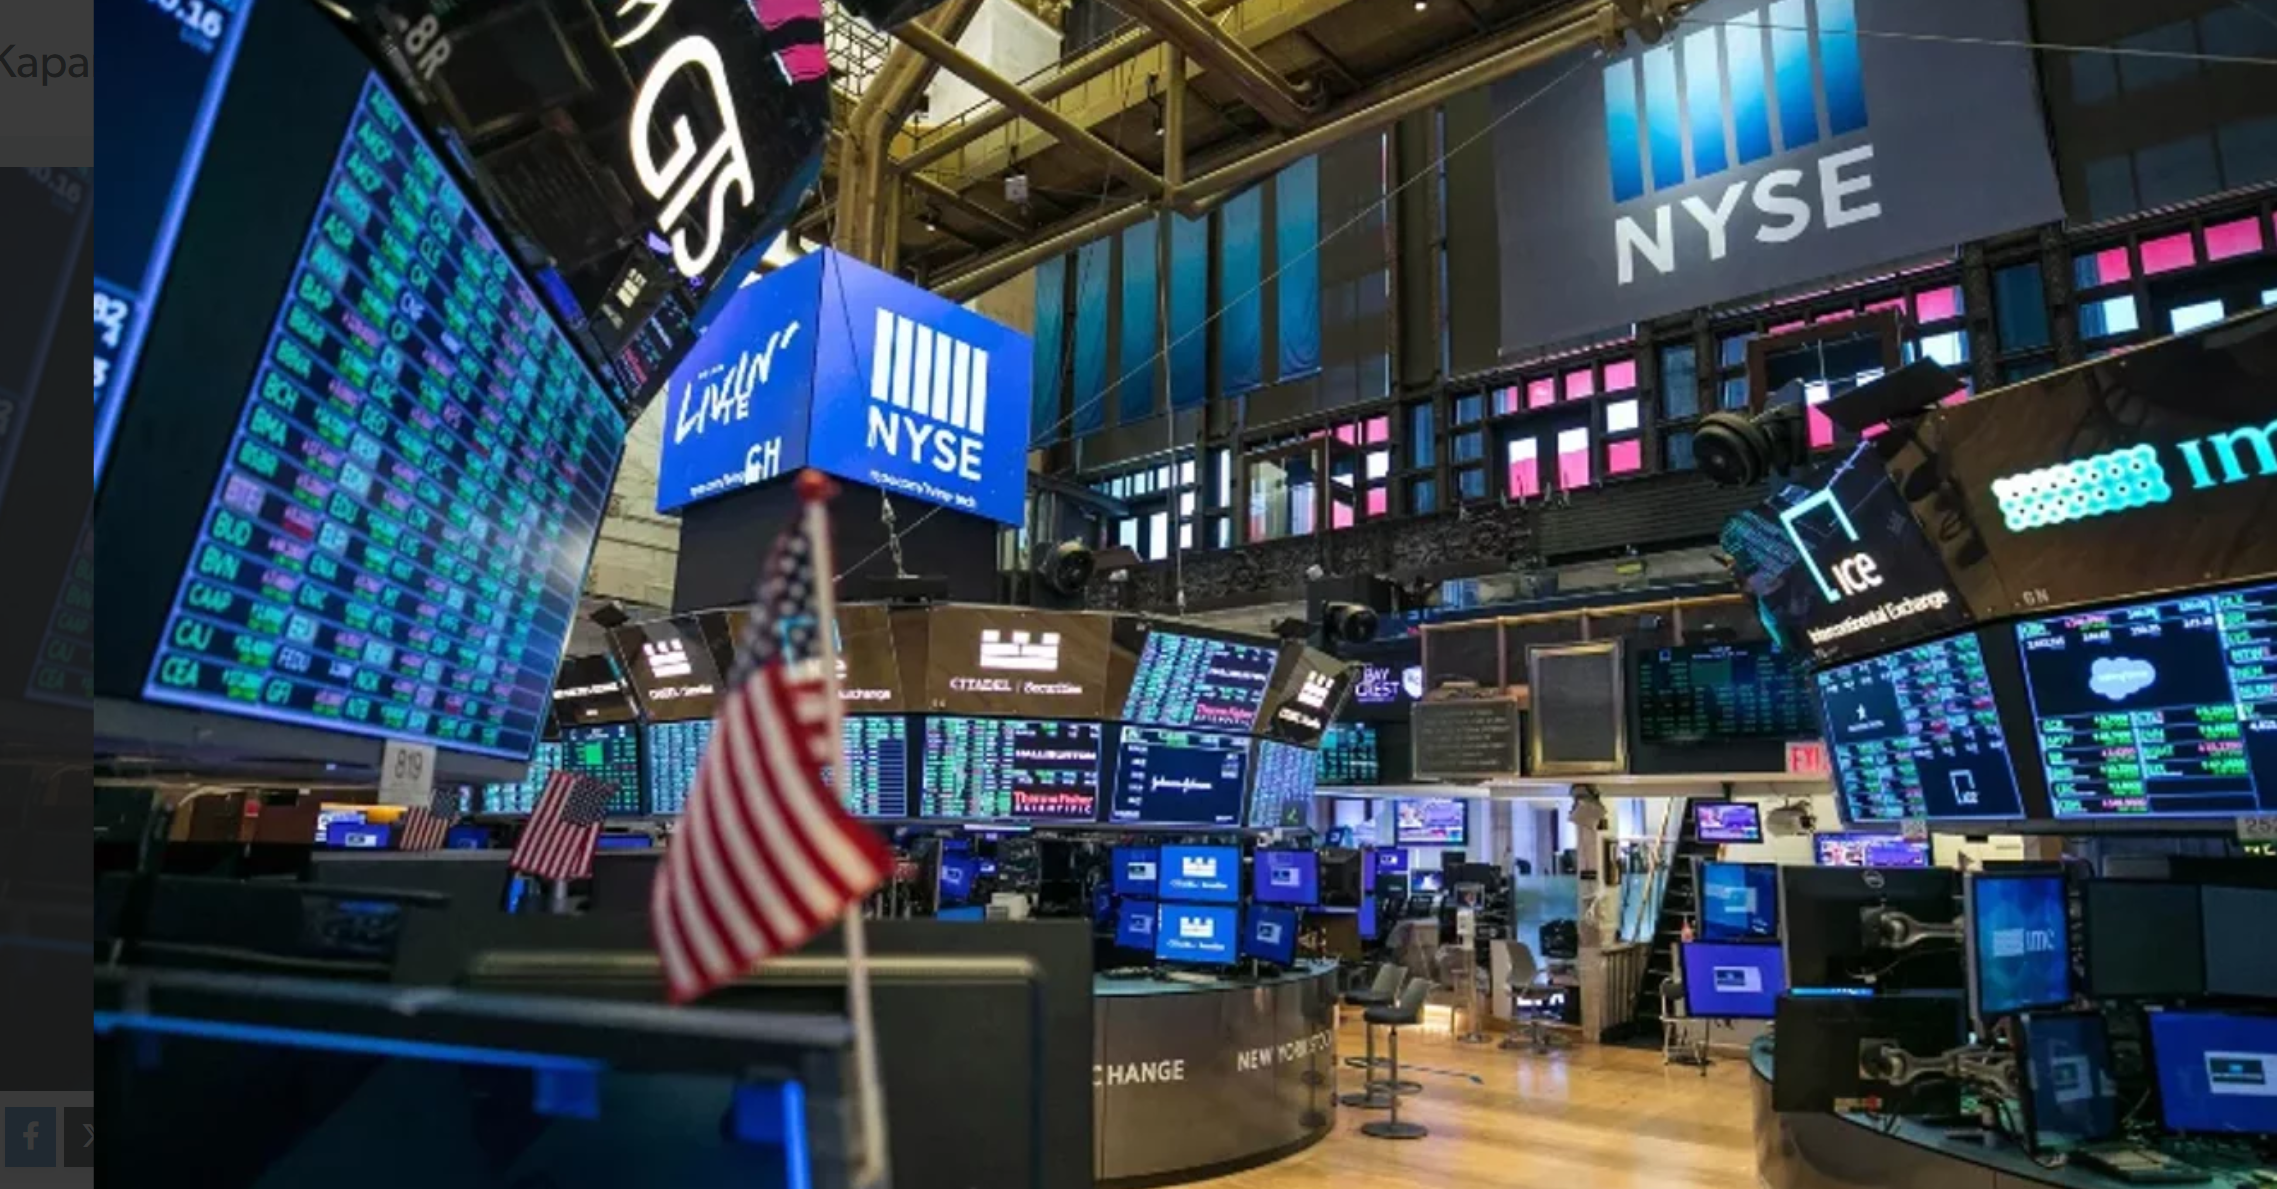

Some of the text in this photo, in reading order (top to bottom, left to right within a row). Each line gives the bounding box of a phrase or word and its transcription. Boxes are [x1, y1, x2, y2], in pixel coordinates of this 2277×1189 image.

[1614, 144, 1882, 286] NYSE
[263, 372, 297, 410] BCH
[251, 406, 286, 444] BMA
[867, 404, 984, 481] NYSE
[213, 511, 250, 545] BUD
[175, 620, 212, 650] CAJ
[162, 657, 199, 684] CEA
[1237, 1049, 1273, 1072] NEW
